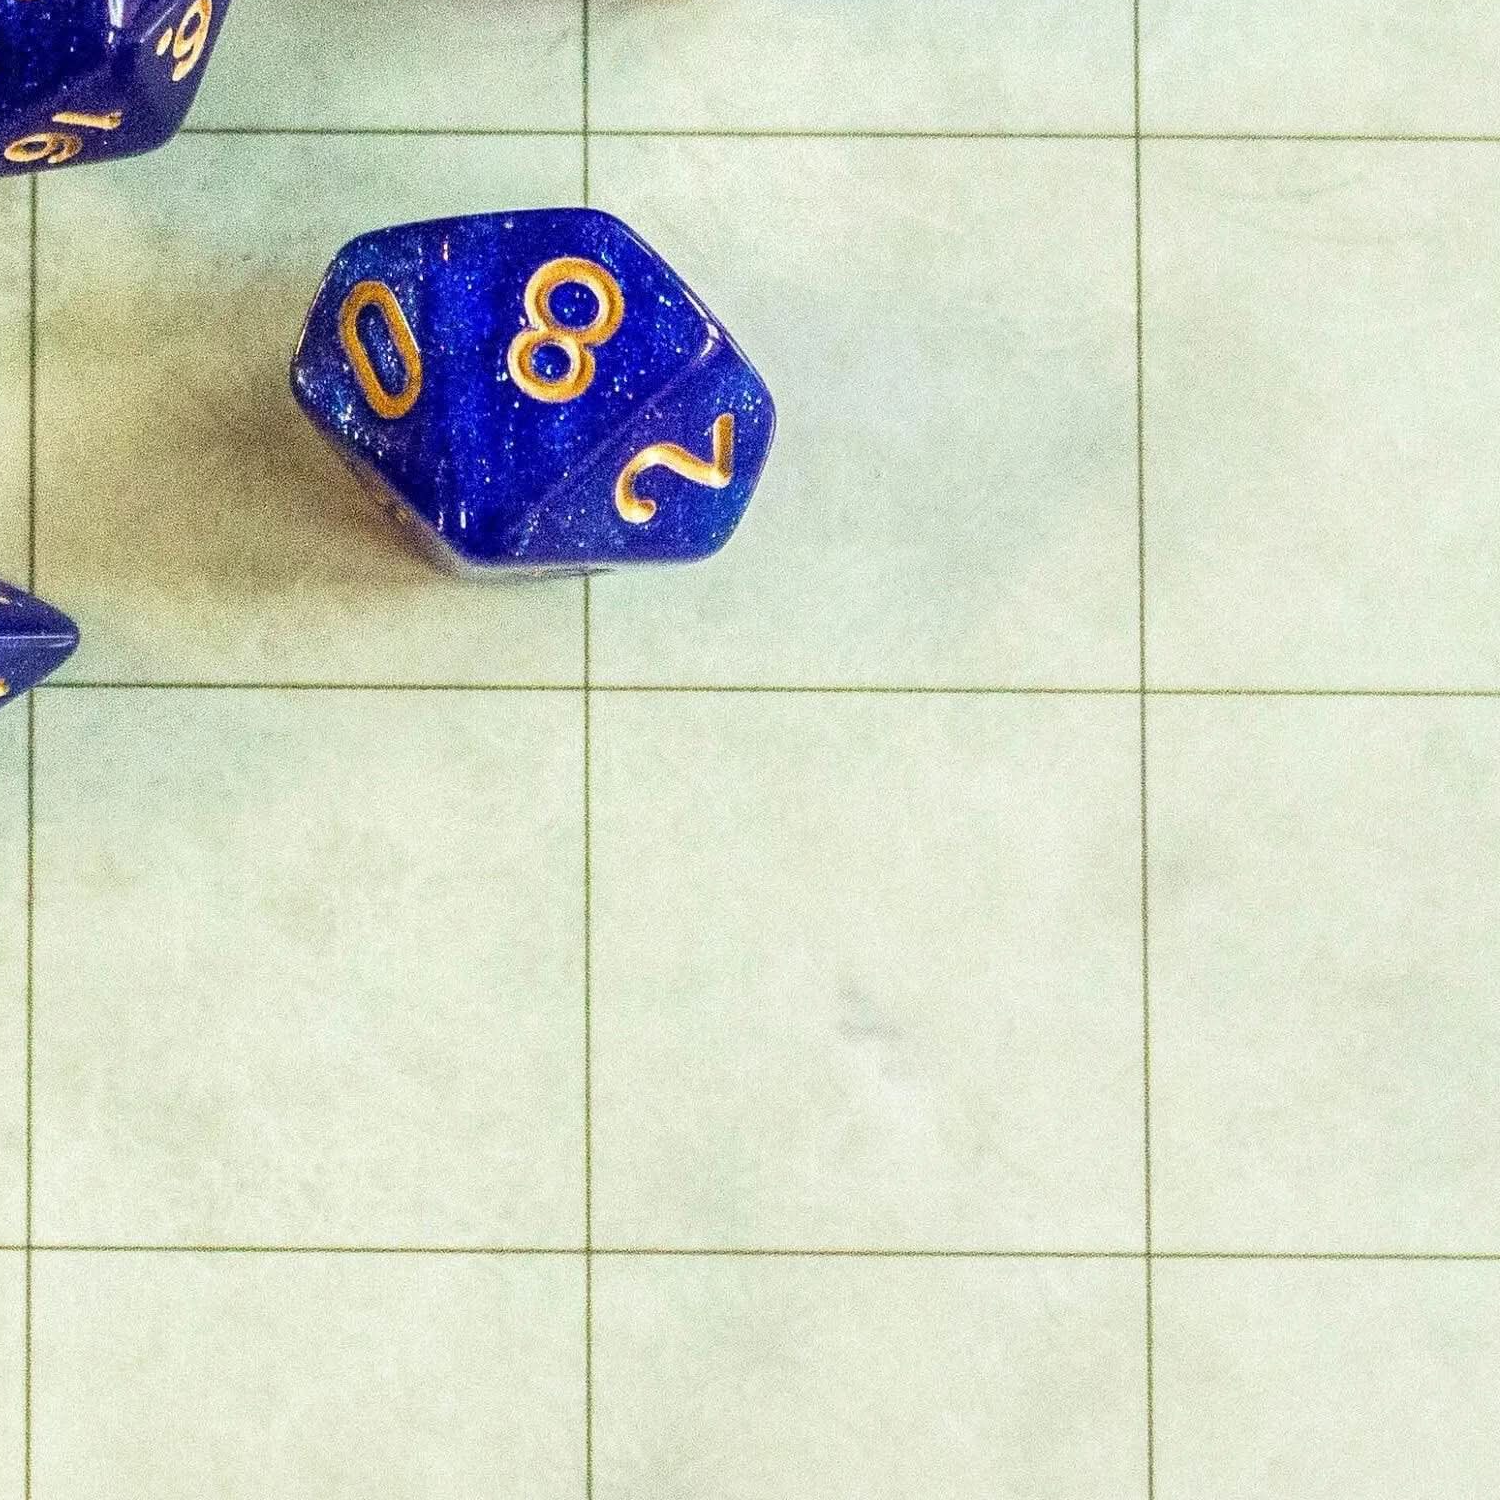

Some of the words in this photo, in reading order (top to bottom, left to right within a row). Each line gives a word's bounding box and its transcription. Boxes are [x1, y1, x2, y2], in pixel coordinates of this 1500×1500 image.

[338, 279, 423, 420] 0
[507, 256, 626, 403] 8
[615, 413, 736, 524] 2
